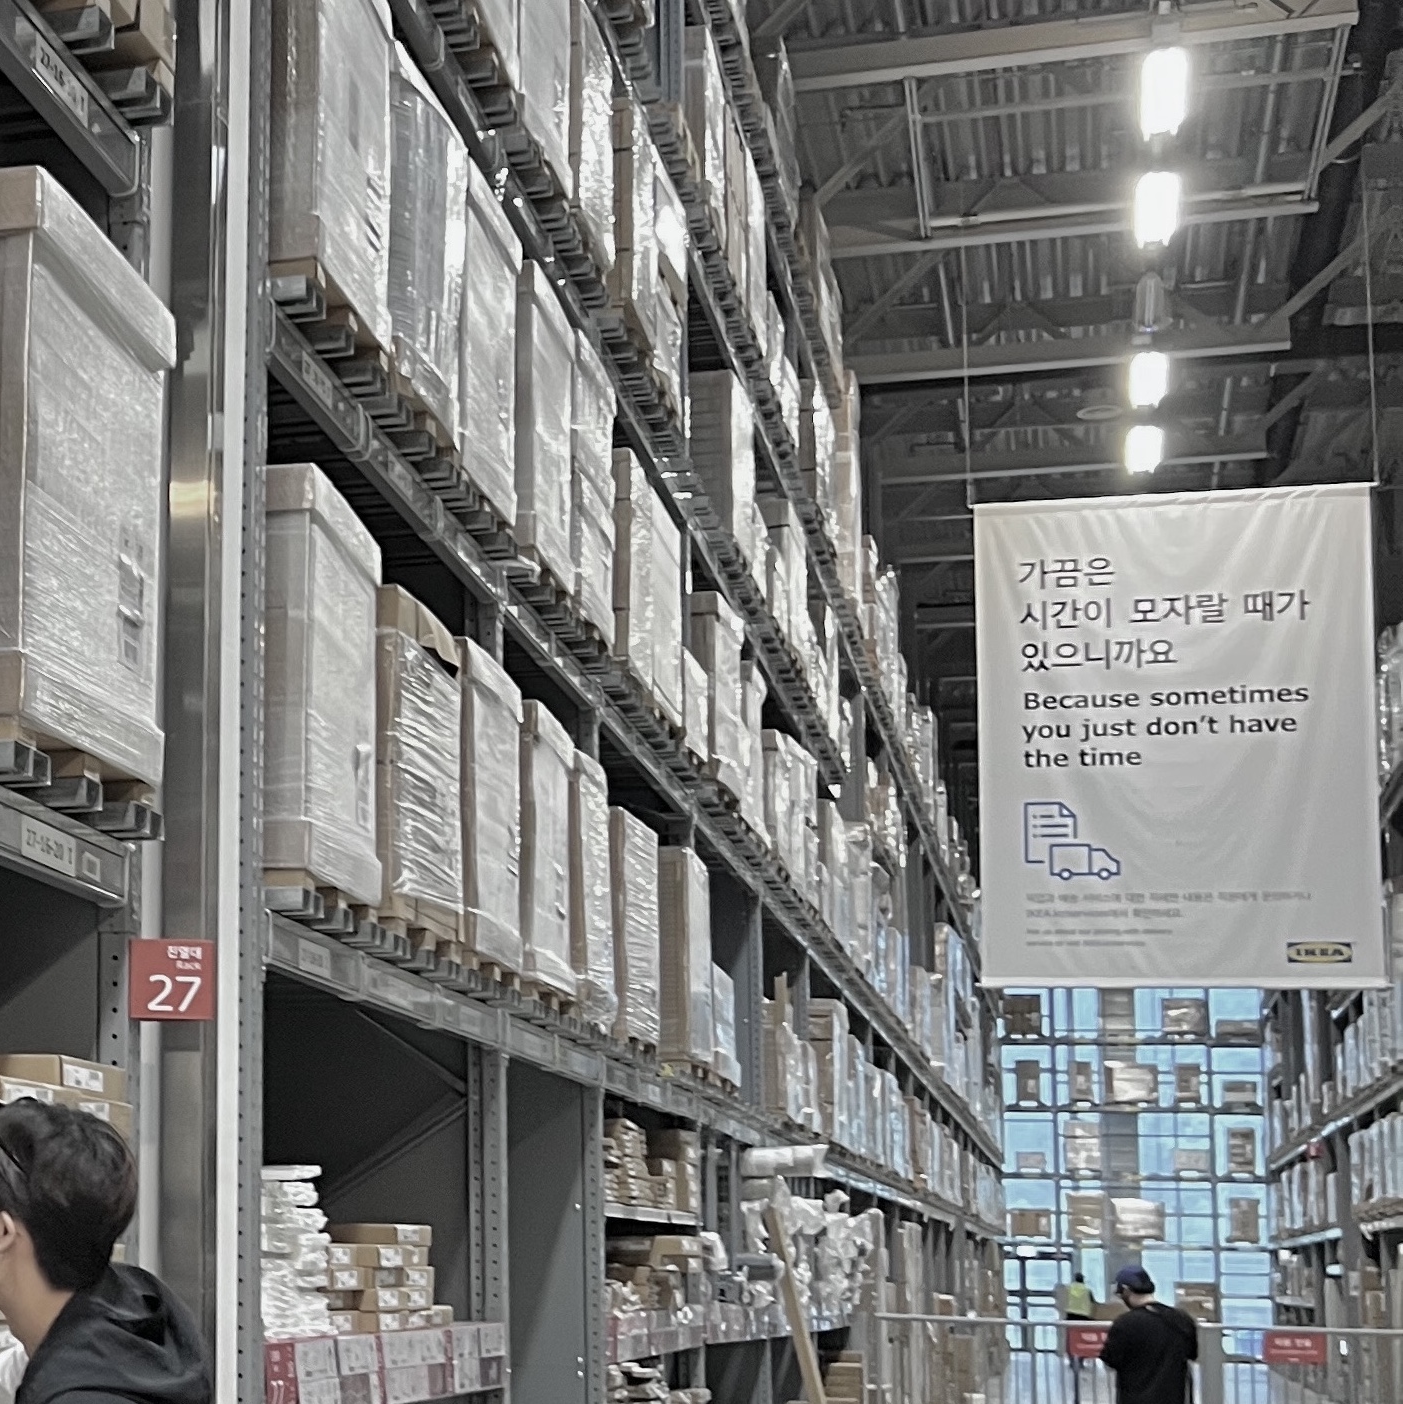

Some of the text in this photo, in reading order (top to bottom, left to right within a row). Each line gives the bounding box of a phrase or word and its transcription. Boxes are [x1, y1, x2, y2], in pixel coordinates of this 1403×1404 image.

[1018, 557, 1115, 590] 가끔은
[1019, 589, 1311, 631] 시간이 모자랄 때가
[1021, 639, 1178, 672] 있으니까요
[1023, 685, 1309, 710] Because sometimes
[1022, 714, 1297, 743] you just don't have
[1024, 747, 1143, 768] the time
[147, 974, 202, 1012] 27
